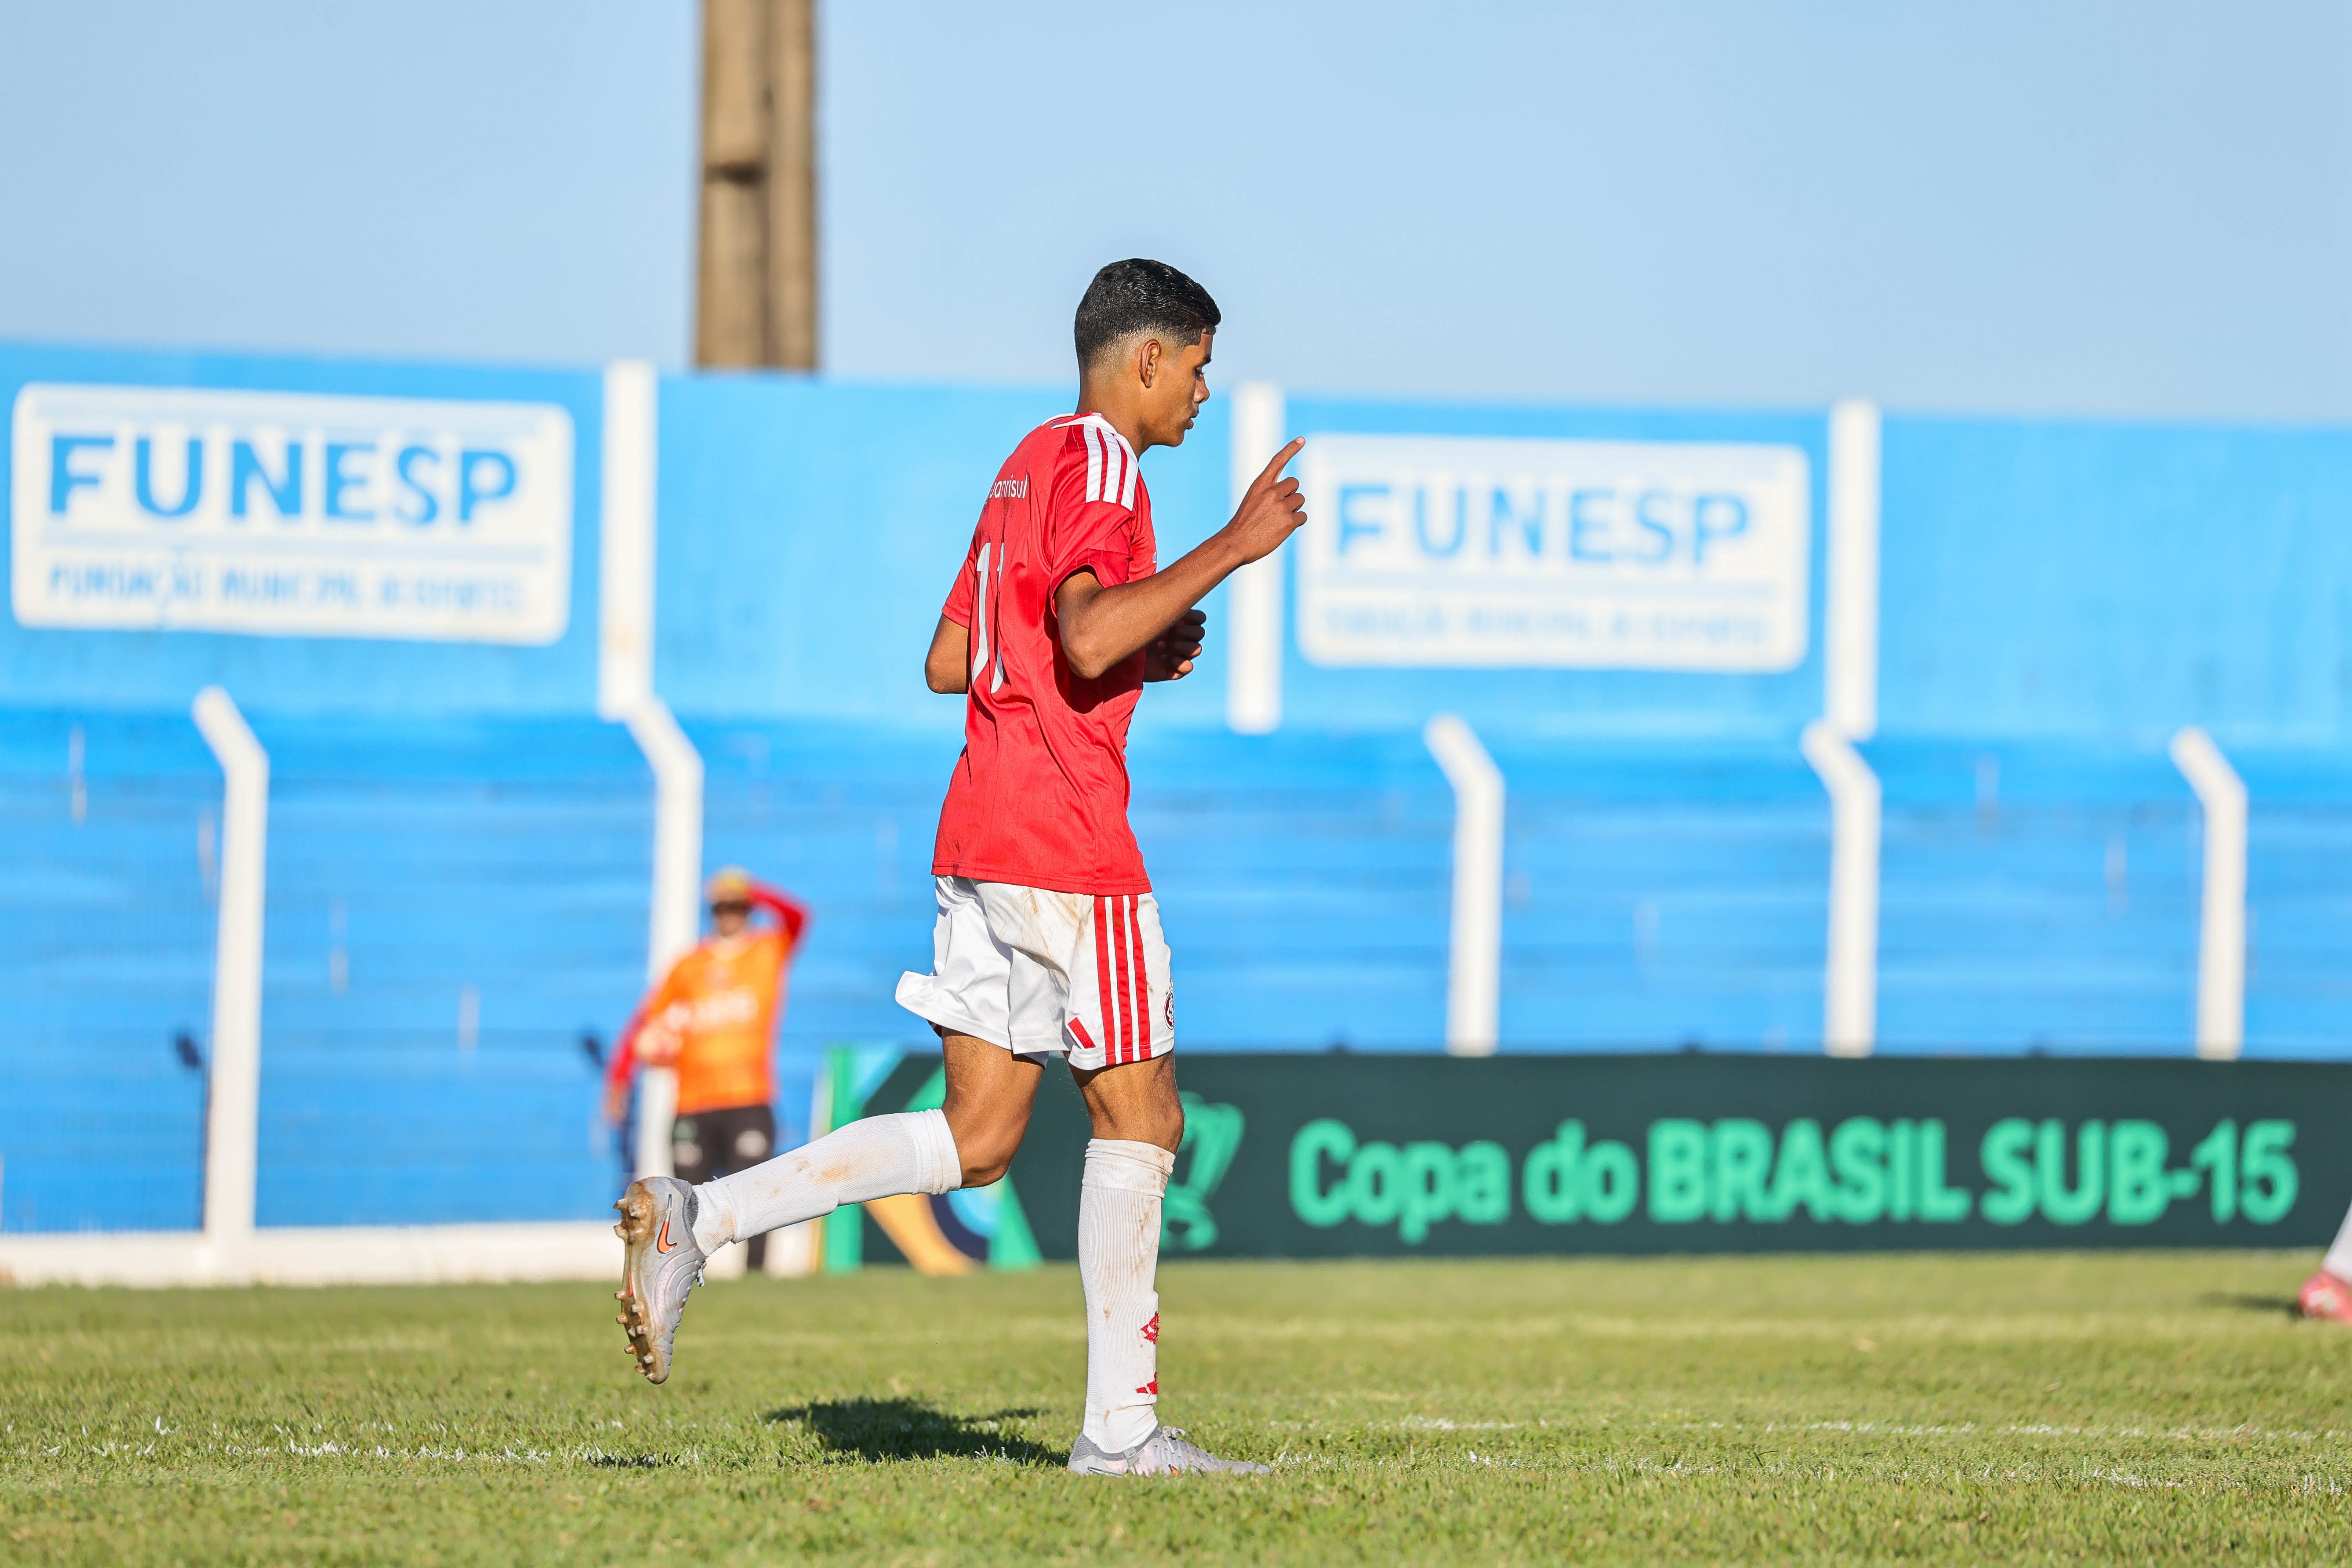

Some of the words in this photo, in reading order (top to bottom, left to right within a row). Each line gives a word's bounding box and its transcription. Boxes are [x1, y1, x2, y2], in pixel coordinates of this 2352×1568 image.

[50, 435, 517, 526] FUNESP
[1336, 483, 1750, 564] FUNESP
[1289, 1118, 1510, 1245] Copa
[1523, 1118, 1639, 1224] do
[1649, 1117, 1971, 1224] BRASIL
[1980, 1117, 2298, 1225] SUB-15
